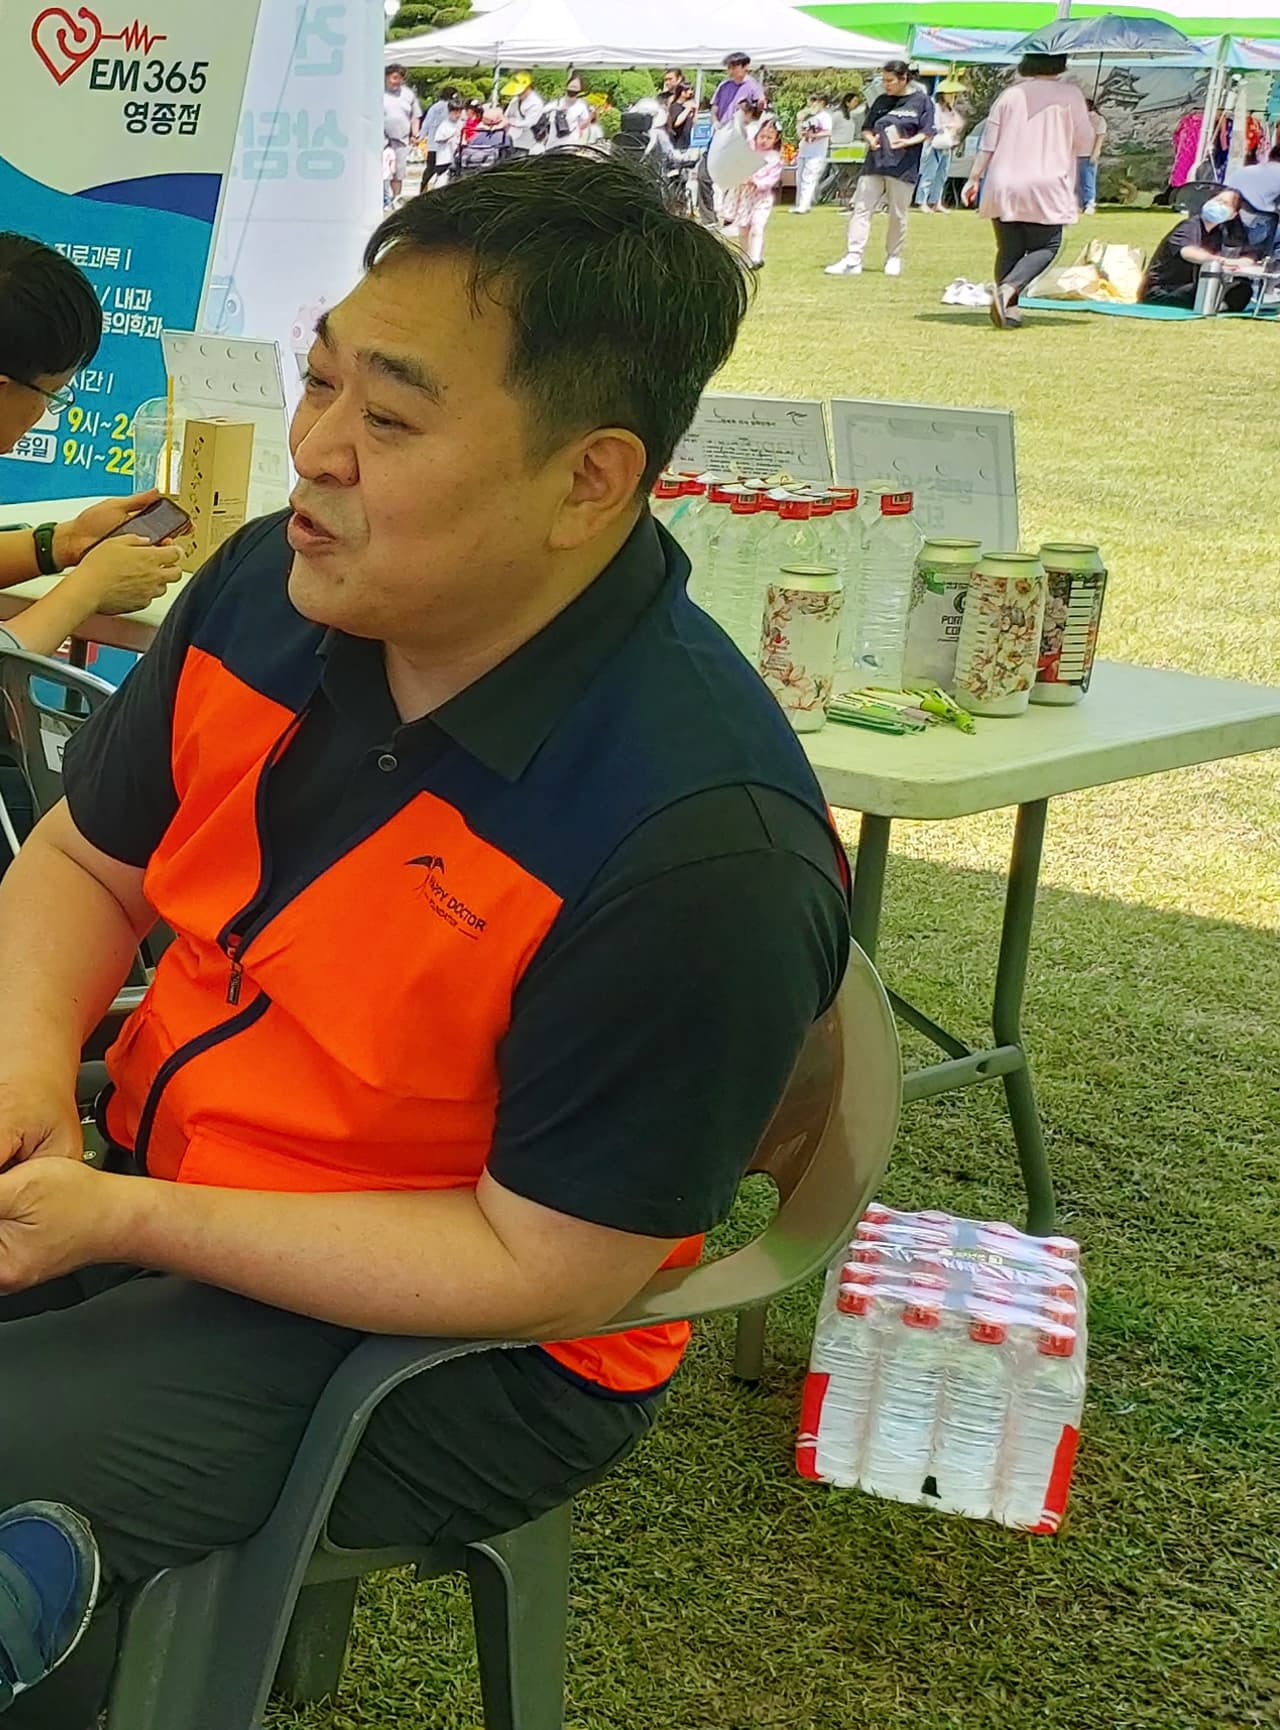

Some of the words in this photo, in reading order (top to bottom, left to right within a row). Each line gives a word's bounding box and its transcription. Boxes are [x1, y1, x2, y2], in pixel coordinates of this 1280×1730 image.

[124, 101, 201, 135] 영종점
[114, 288, 152, 312] 내과
[10, 437, 48, 458] 휴일
[447, 896, 486, 932] DOCTOR
